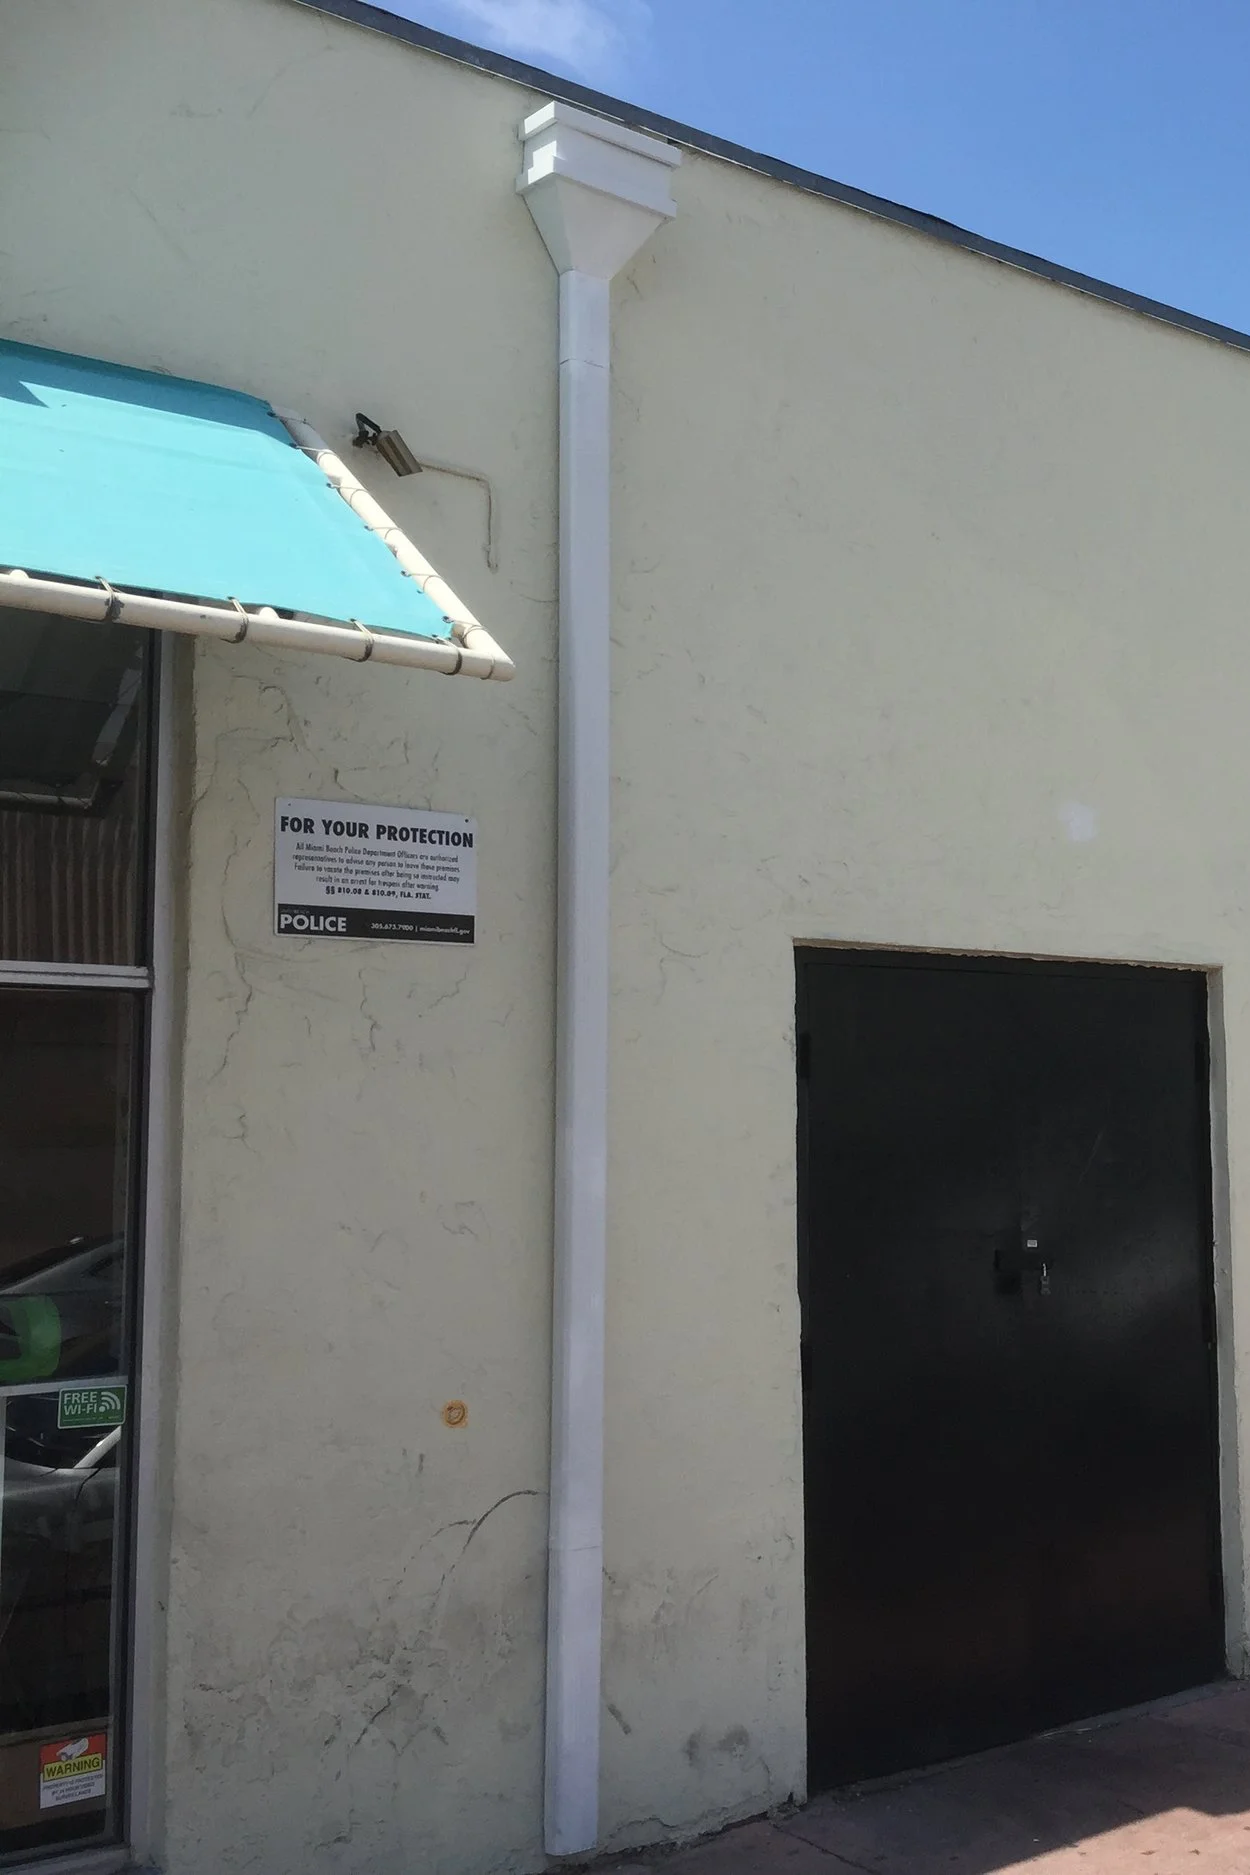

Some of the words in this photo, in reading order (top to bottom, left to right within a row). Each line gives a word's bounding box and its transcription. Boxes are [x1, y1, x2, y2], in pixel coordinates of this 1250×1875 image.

[280, 816, 315, 834] FOR
[322, 819, 369, 839] YOUR
[376, 825, 473, 848] PROTECTION
[293, 853, 337, 864] representatives
[346, 857, 363, 865] advise
[365, 860, 375, 868] any
[377, 860, 396, 869] person
[405, 862, 419, 870] leave
[306, 844, 324, 852] Miami
[326, 845, 343, 854] Beach
[345, 846, 361, 855] Police
[362, 848, 396, 858] Department
[397, 851, 417, 859] Officers
[430, 853, 458, 862] authorized
[295, 863, 315, 872] Failure
[324, 866, 343, 874] vacate
[344, 867, 353, 875] the
[355, 869, 380, 877] premises
[381, 869, 395, 877] after
[396, 870, 412, 880] being
[421, 872, 446, 881] instructed
[316, 876, 332, 884] result
[350, 878, 367, 886] arrest
[368, 878, 376, 886] for
[378, 880, 400, 888] trespass
[401, 880, 415, 888] after
[338, 887, 362, 895] 810.08
[372, 890, 398, 898] 810.09,
[280, 914, 347, 932] POLICE
[64, 1391, 98, 1404] FREE
[64, 1403, 97, 1416] WI-FI
[46, 1757, 100, 1778] WARNING
